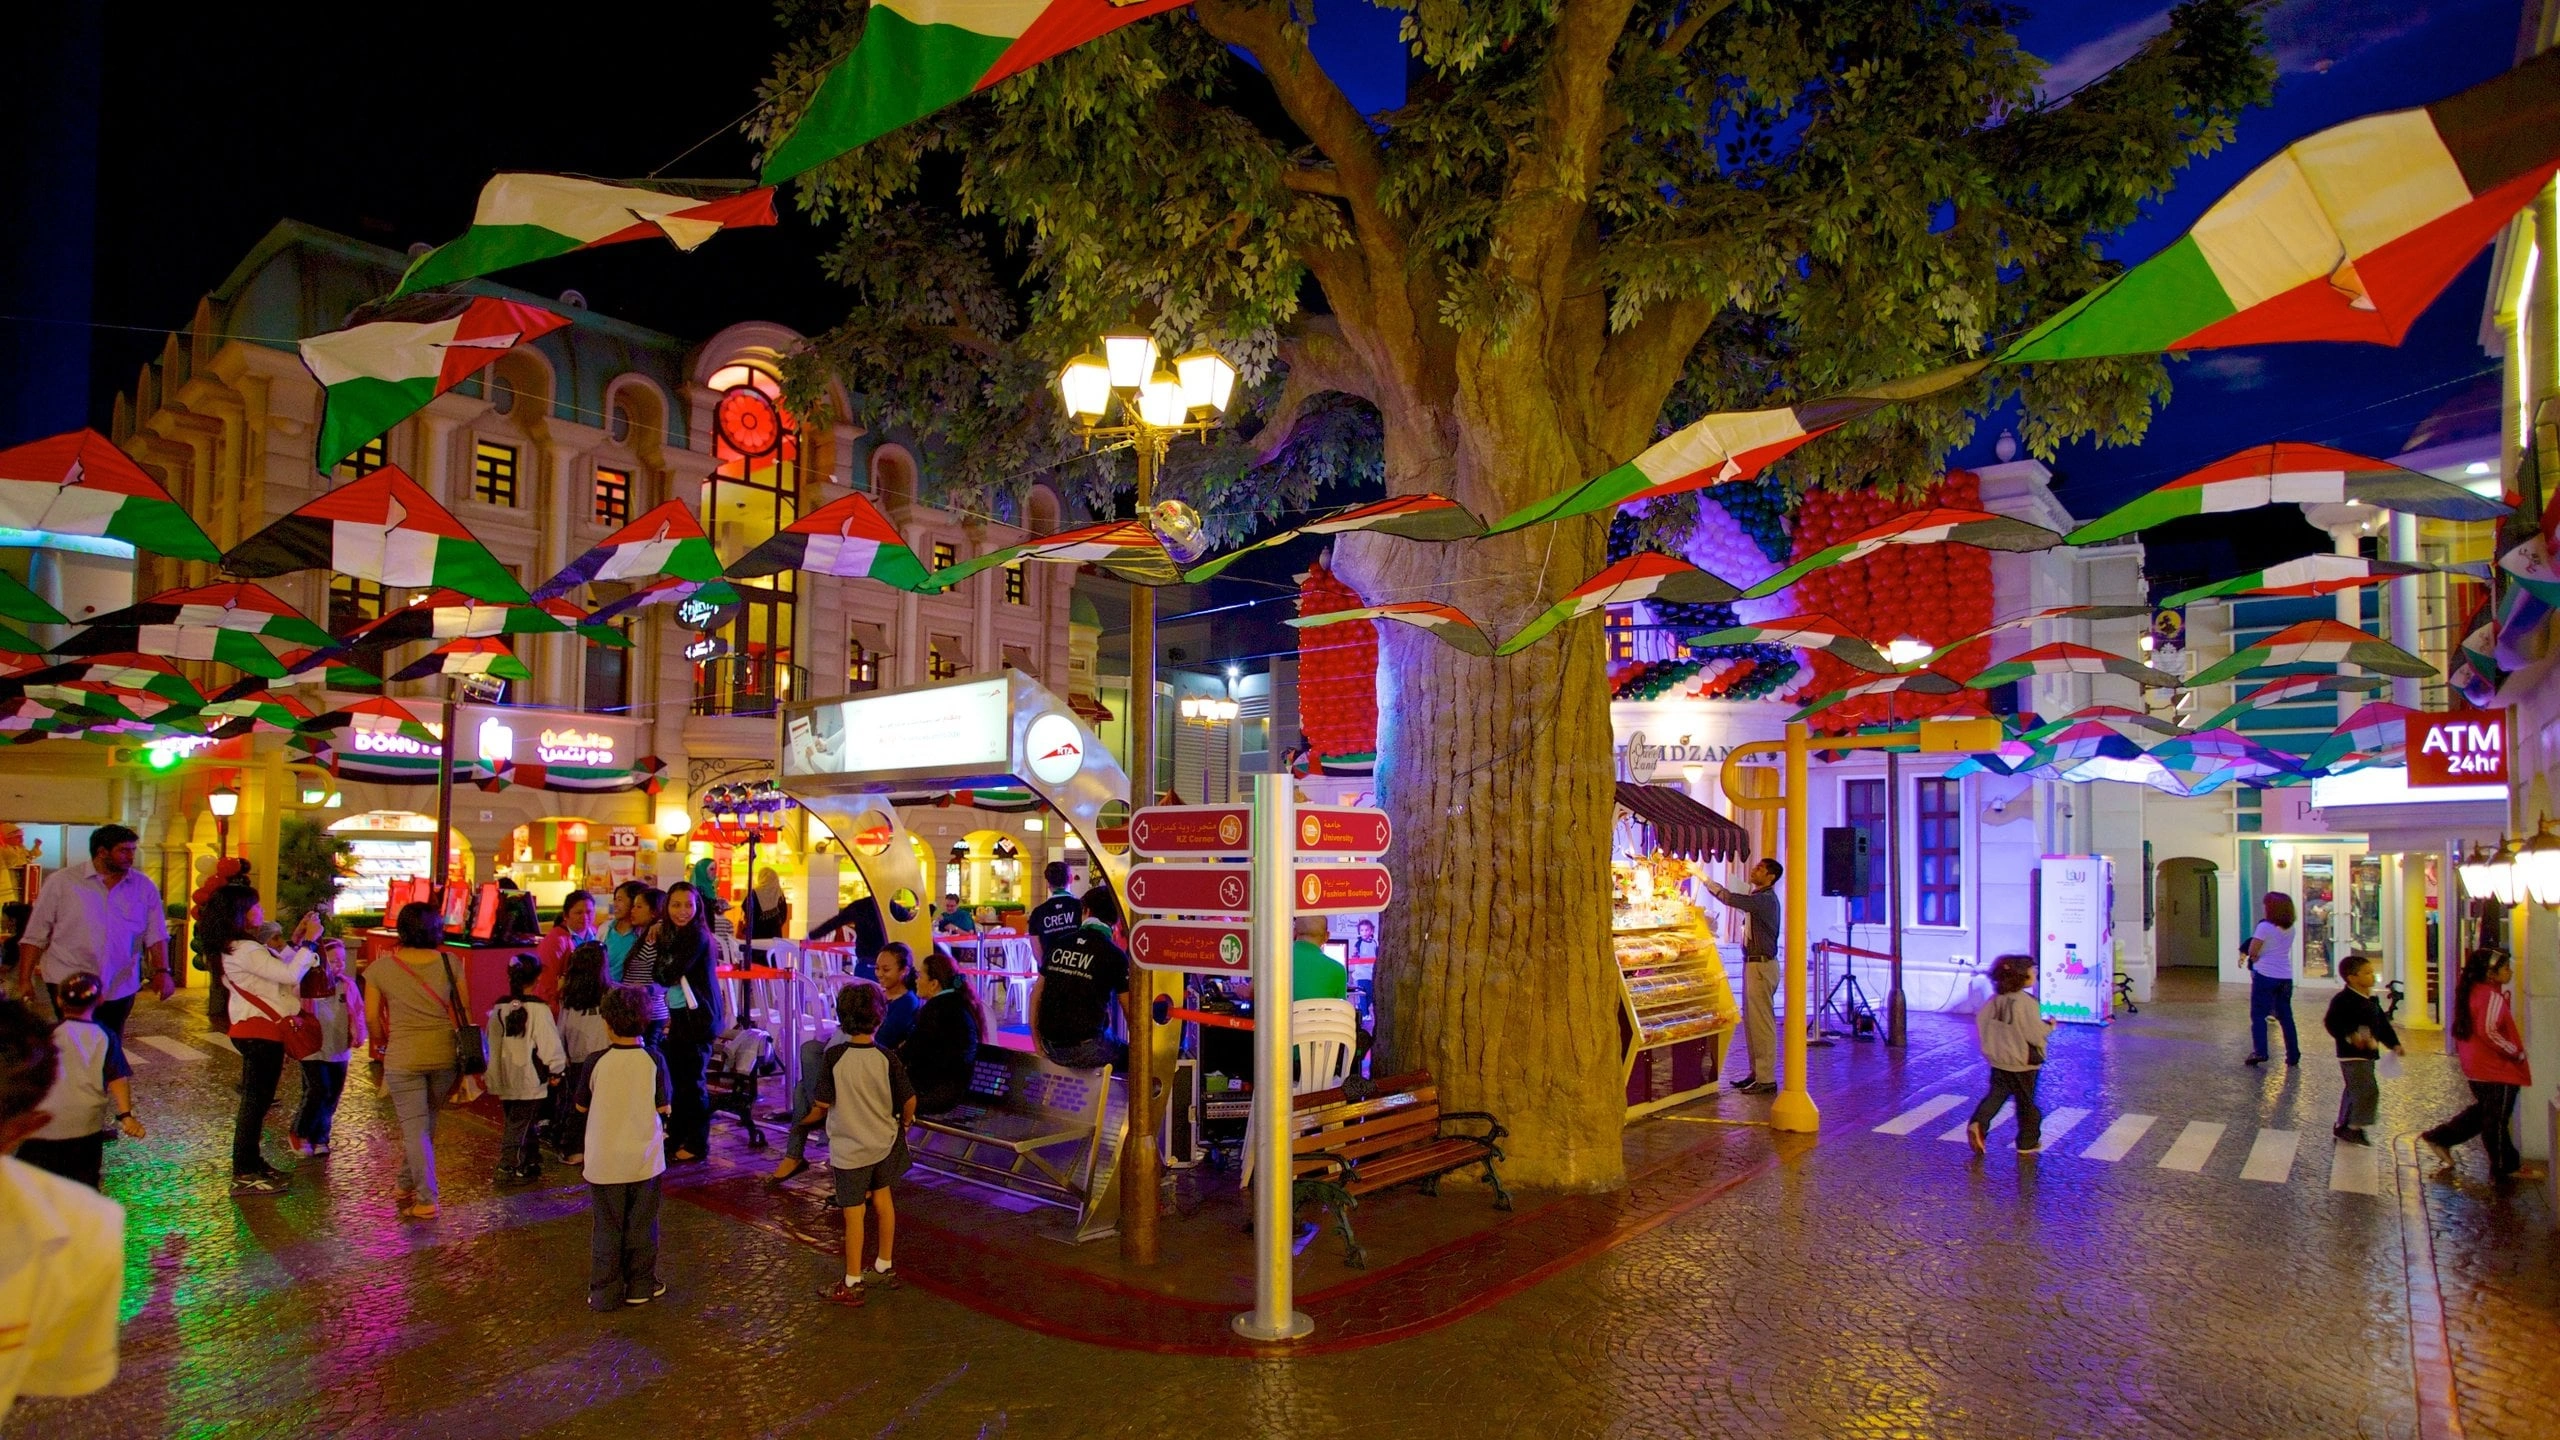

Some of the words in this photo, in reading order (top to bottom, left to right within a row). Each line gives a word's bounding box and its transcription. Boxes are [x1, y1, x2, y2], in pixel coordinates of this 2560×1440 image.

[354, 733, 443, 756] DONU
[2421, 723, 2500, 753] ATM
[1633, 758, 1659, 770] Land
[2447, 753, 2500, 774] 24hr
[614, 833, 635, 847] 10
[1176, 835, 1187, 843] KZ
[1188, 835, 1215, 843] Corner
[1323, 833, 1354, 844] University
[1323, 889, 1347, 898] Fashion
[1347, 888, 1374, 898] Boutique
[1043, 911, 1075, 928] CREW
[1051, 948, 1095, 970] CREW
[1163, 949, 1198, 960] Migration
[1199, 951, 1215, 960] Exit
